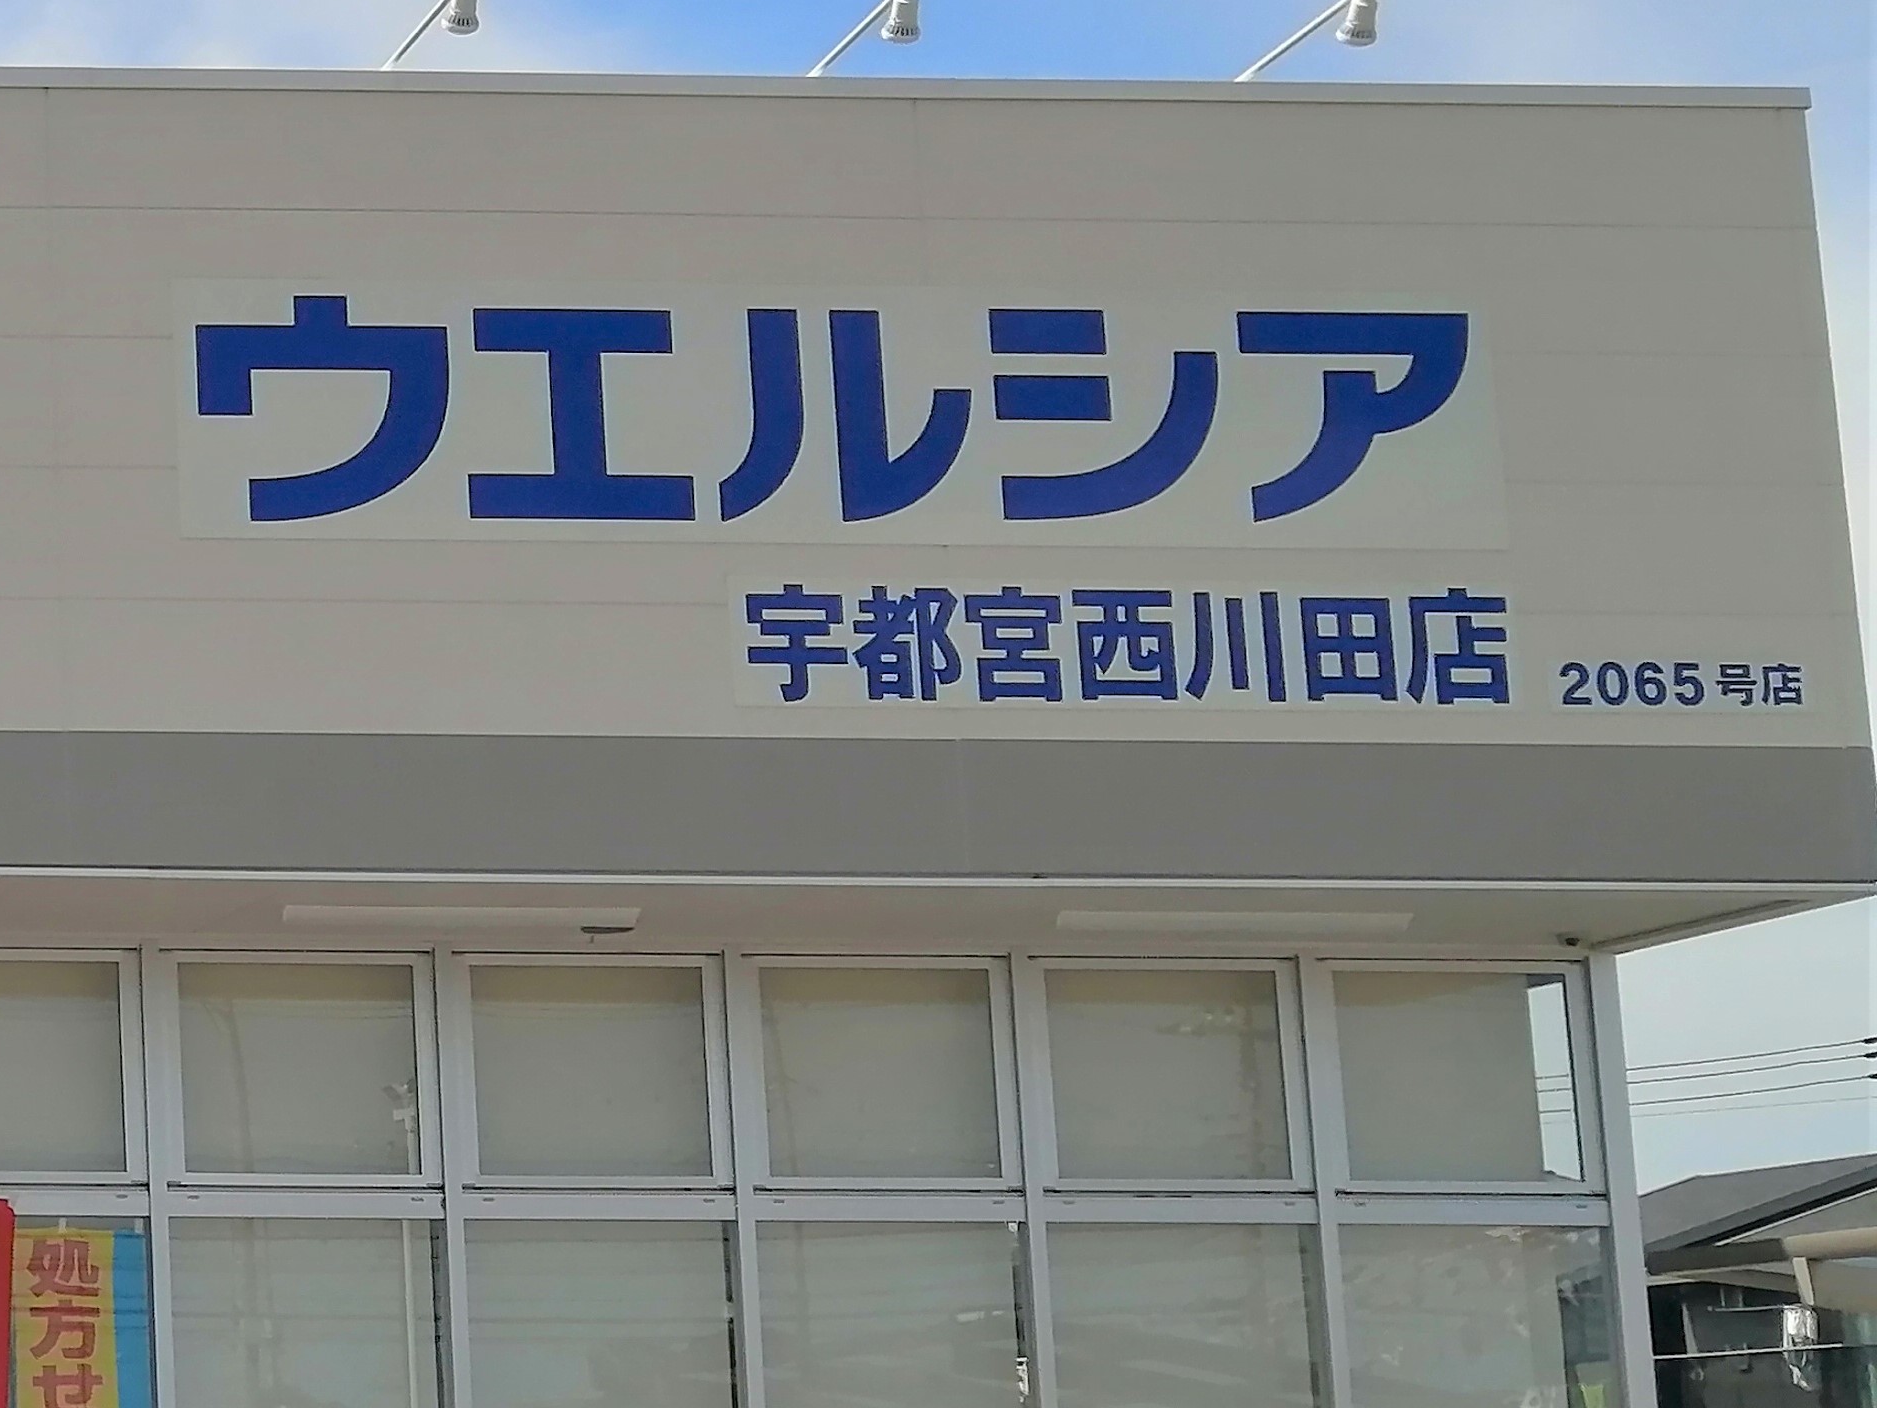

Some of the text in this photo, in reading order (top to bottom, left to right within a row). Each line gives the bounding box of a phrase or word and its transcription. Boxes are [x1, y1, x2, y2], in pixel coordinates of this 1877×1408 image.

[195, 294, 1470, 524] ウエルシア
[745, 584, 1512, 708] 宇都宮西川田店
[1558, 659, 1806, 710] 2065号店
